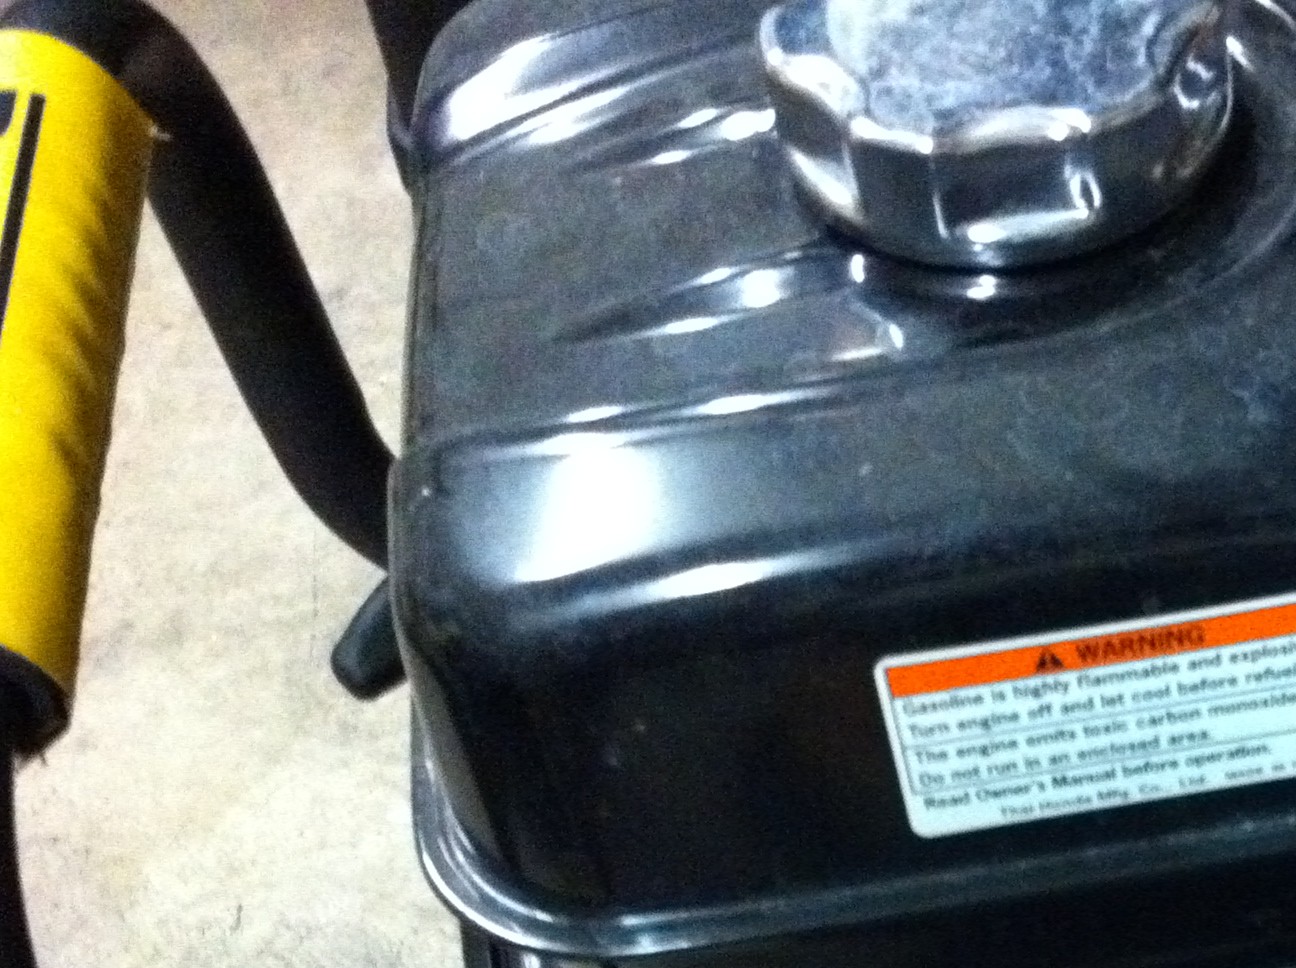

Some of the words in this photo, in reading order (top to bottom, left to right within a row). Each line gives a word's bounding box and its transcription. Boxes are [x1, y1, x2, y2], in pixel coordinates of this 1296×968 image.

[1076, 625, 1205, 662] WARNING
[902, 694, 985, 716] Gasoline
[991, 689, 1006, 702] is
[1012, 679, 1070, 701] highly
[1077, 661, 1180, 689] flammable
[1187, 652, 1222, 671] and
[909, 723, 950, 738] Turn
[956, 712, 1019, 732] engine
[1027, 703, 1053, 719] off
[1060, 697, 1095, 716] and
[1100, 693, 1125, 709] let
[1131, 683, 1171, 702] cool
[1176, 674, 1238, 696] before
[916, 749, 949, 764] The
[956, 739, 1019, 758] engine
[1026, 730, 1077, 747] emits
[1083, 721, 1129, 738] toxic
[1136, 708, 1202, 729] carbon
[918, 772, 946, 787] Do
[951, 766, 981, 782] not
[987, 761, 1018, 775] run
[1024, 756, 1042, 770] in
[1048, 752, 1071, 766] an
[1077, 735, 1161, 760] enclosed
[923, 790, 970, 809] Read
[1051, 768, 1118, 789] Manual
[1121, 759, 1180, 778] before
